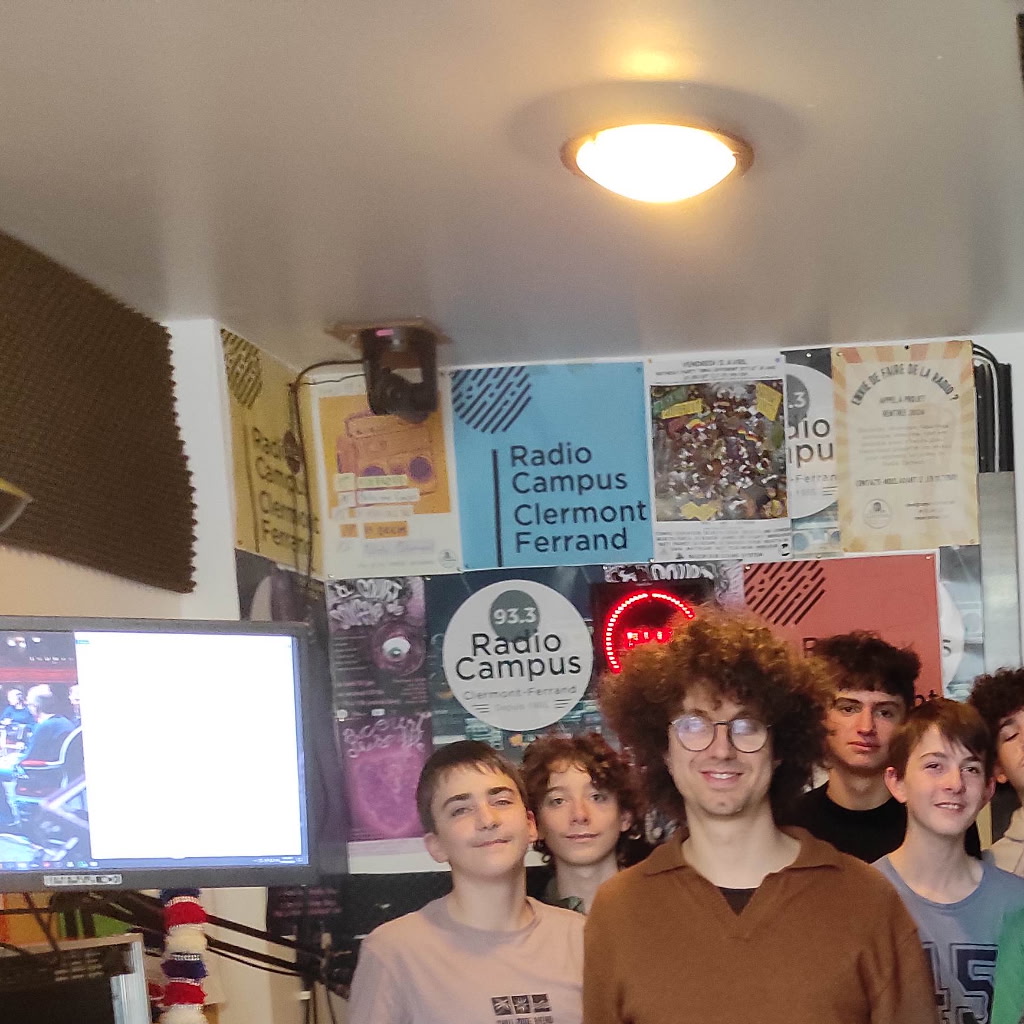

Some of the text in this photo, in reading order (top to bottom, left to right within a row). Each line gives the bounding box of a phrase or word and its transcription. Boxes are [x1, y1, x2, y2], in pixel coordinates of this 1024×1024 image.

[919, 367, 931, 378] LA
[510, 441, 593, 468] Radio
[511, 471, 629, 496] Campus
[513, 500, 648, 526] Clermont
[515, 527, 628, 554] Ferrand
[493, 606, 537, 625] 93.3
[472, 629, 562, 657] Radio
[455, 655, 581, 682] Campus
[463, 686, 578, 701] Clermont-Ferrand
